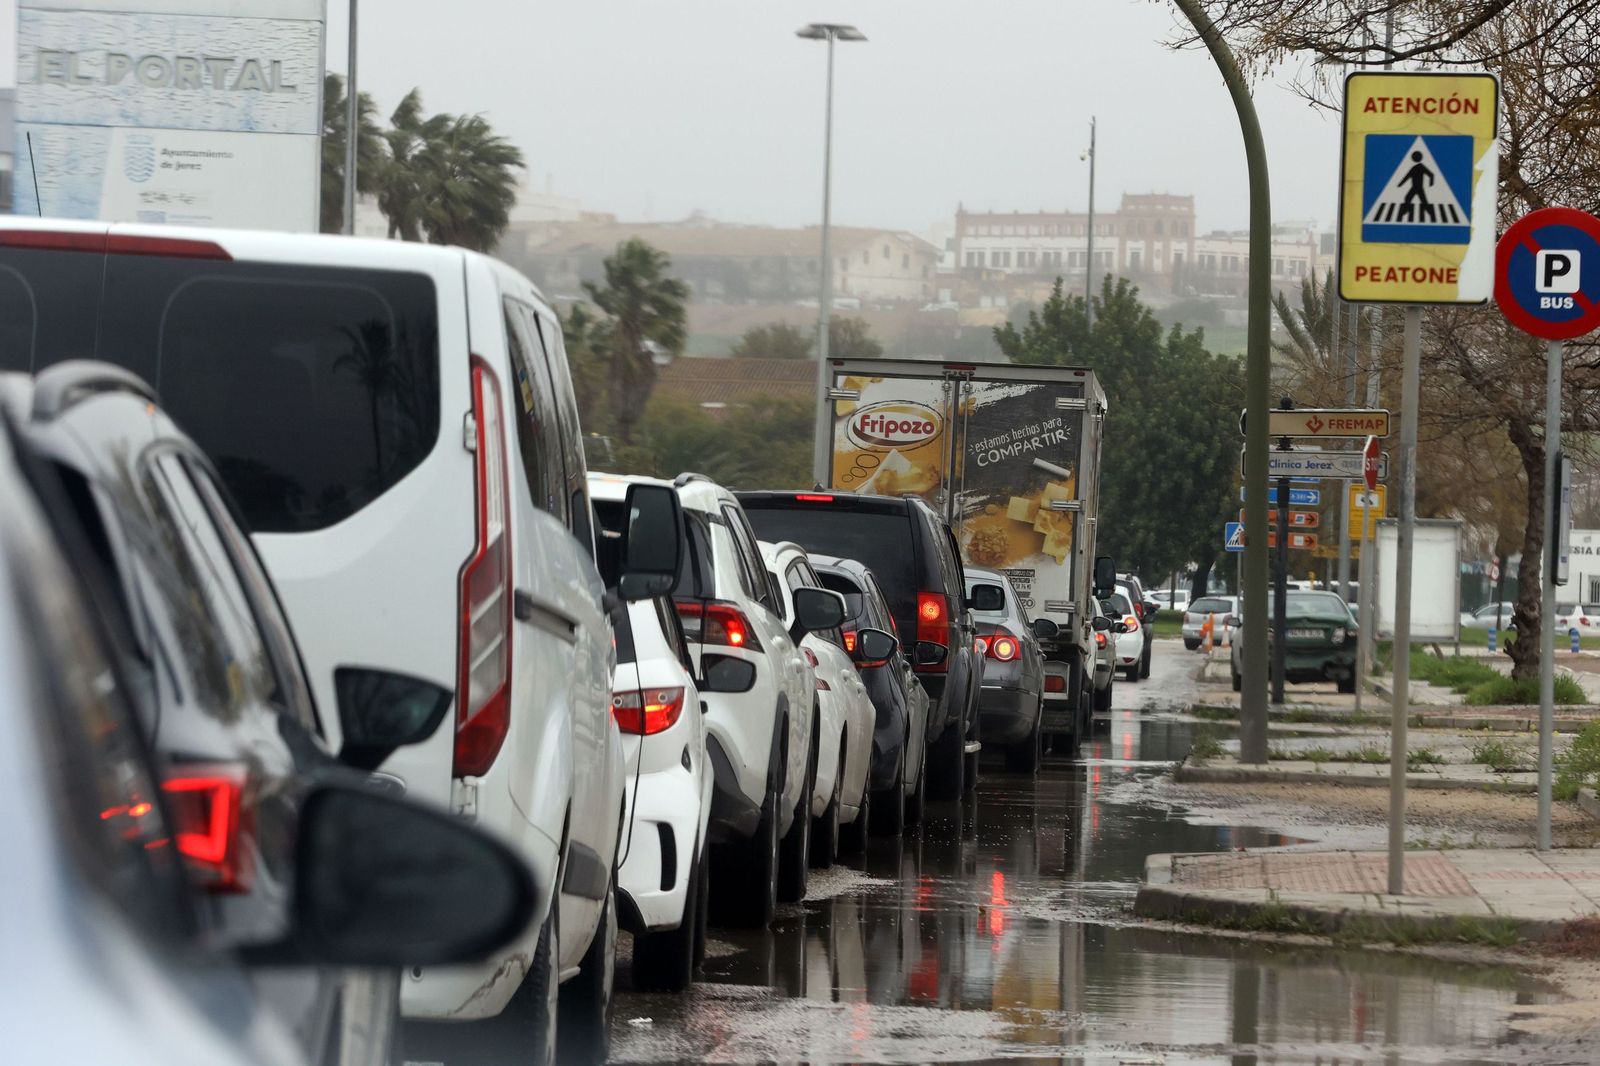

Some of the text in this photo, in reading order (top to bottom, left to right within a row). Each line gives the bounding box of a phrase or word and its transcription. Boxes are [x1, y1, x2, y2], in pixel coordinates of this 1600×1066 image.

[37, 49, 297, 93] EL PORTAL
[1364, 93, 1479, 114] ATENCIÓN
[160, 148, 234, 159] Ayuntamiento
[175, 161, 202, 171] Jerez
[1355, 266, 1457, 284] PEATONE
[1544, 254, 1571, 288] P
[1540, 296, 1574, 310] BUS
[860, 414, 935, 438] Fripozo
[1328, 418, 1384, 430] FREMAP
[975, 417, 1063, 453] estamos hechos para
[976, 429, 1068, 467] COMPARTIR
[1305, 460, 1333, 470] Jerez
